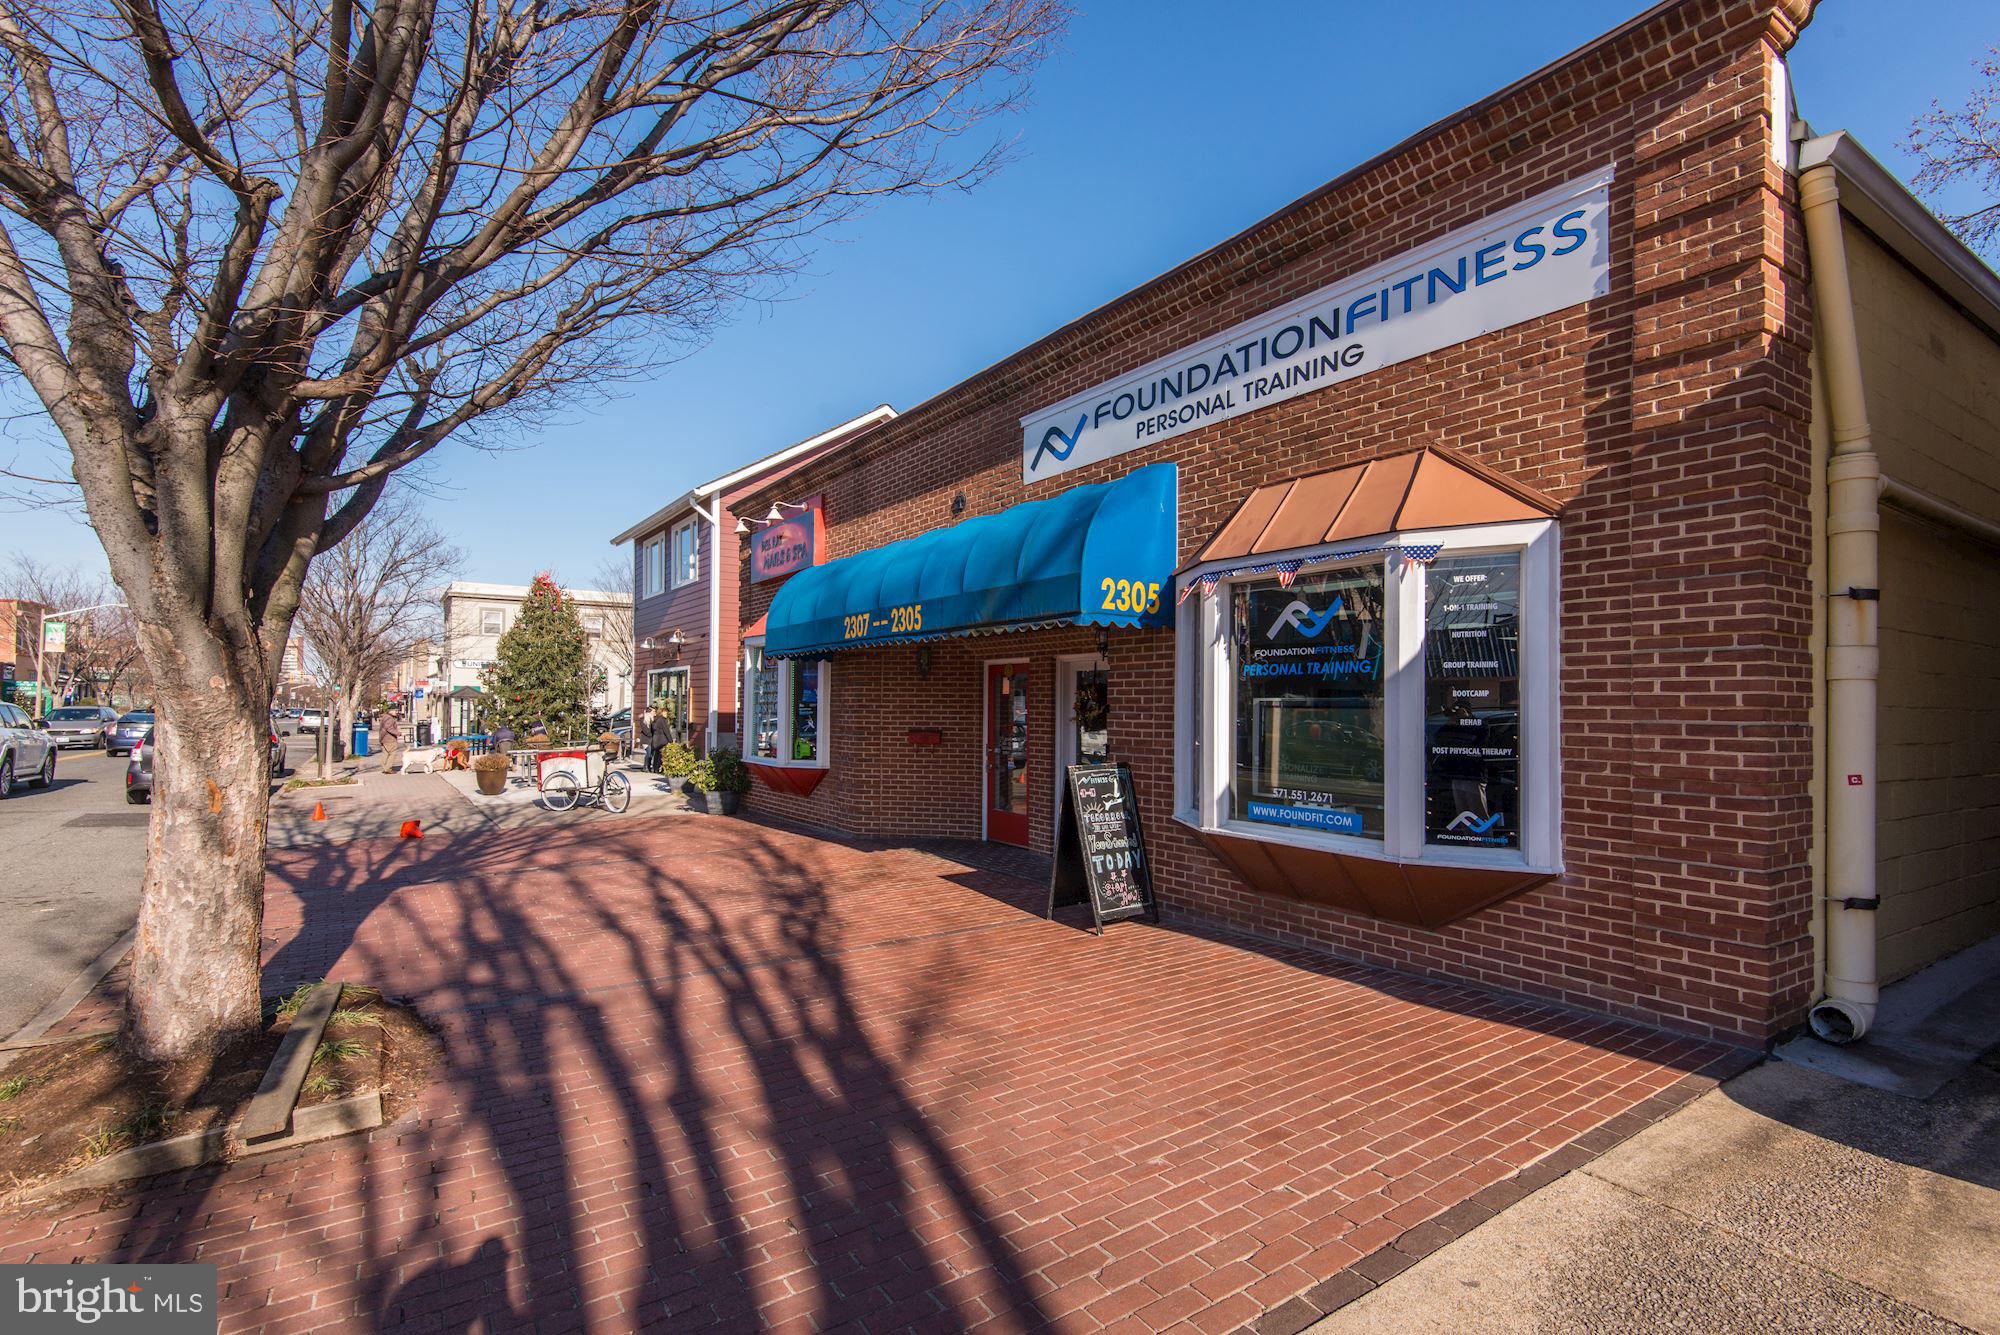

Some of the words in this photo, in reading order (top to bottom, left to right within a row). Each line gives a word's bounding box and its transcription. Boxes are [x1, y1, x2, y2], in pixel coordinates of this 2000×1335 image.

[1135, 388, 1236, 440] PERSONAL
[1242, 343, 1365, 404] TRAINING
[792, 541, 808, 561] SPA
[1453, 575, 1464, 583] WE
[1465, 574, 1488, 583] OFFER:
[1101, 576, 1161, 615] 2305
[1443, 603, 1465, 612] 1-ON-1
[1466, 602, 1498, 611] TRAINING
[844, 613, 870, 640] 2307
[890, 604, 922, 633] 2305
[1451, 630, 1487, 639] NUTRITION
[1243, 662, 1304, 678] PERSONAL
[1306, 659, 1372, 676] TRAINING
[1443, 661, 1466, 669] GROUP
[1467, 660, 1499, 669] TRAINING
[1452, 689, 1490, 698] BOOTCAMP
[1459, 718, 1483, 727] REHAB
[1432, 746, 1448, 755] POST
[1449, 747, 1481, 756] PHYSICAL
[1481, 747, 1512, 757] THERAPY
[1272, 788, 1333, 804] 571.551.2671
[1252, 805, 1353, 827] WWW.FOUNDFIT.COM
